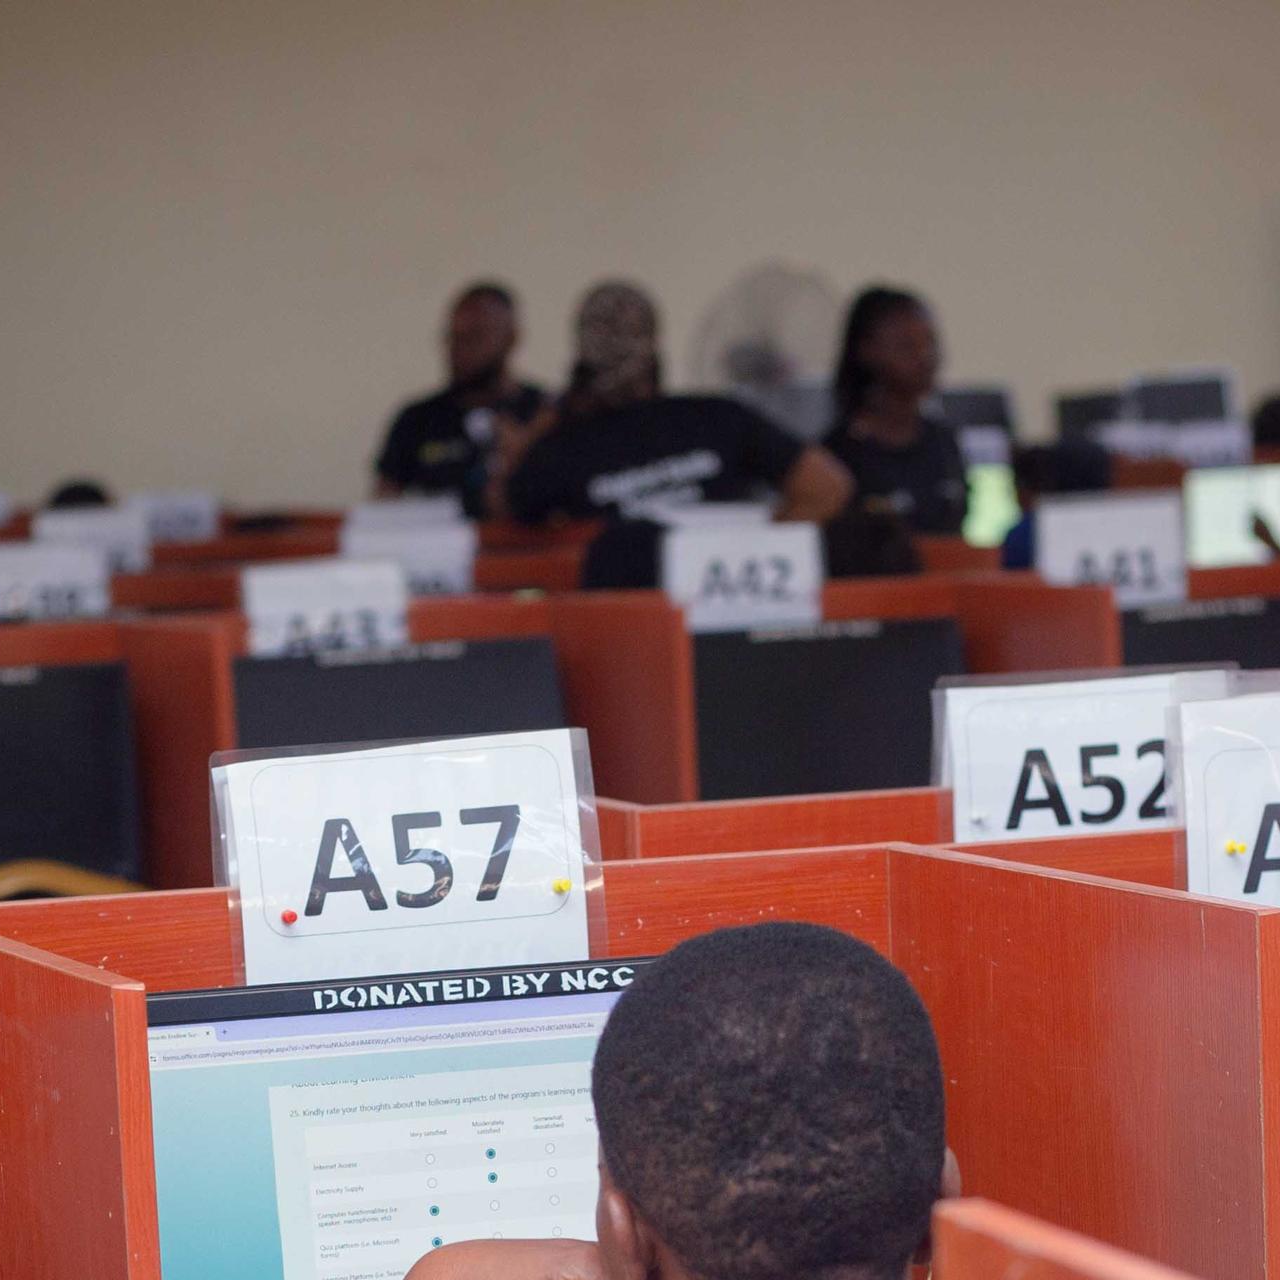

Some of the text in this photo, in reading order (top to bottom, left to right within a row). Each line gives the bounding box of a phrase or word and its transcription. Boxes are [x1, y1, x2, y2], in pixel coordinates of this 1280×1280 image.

[700, 556, 794, 600] A42
[1006, 738, 1168, 831] A52
[304, 804, 521, 917] A57
[313, 966, 635, 1010] DONATED BY NCC
[302, 1107, 324, 1118] Kindly
[326, 1106, 340, 1115] rate
[342, 1105, 358, 1115] your
[360, 1101, 391, 1113] thoughts
[392, 1100, 413, 1110] about
[415, 1099, 427, 1108] the
[428, 1096, 461, 1107] following
[462, 1092, 488, 1105] aspects
[489, 1092, 497, 1102] of
[498, 1091, 509, 1100] the
[511, 1089, 546, 1101] program's
[547, 1086, 576, 1098] learning
